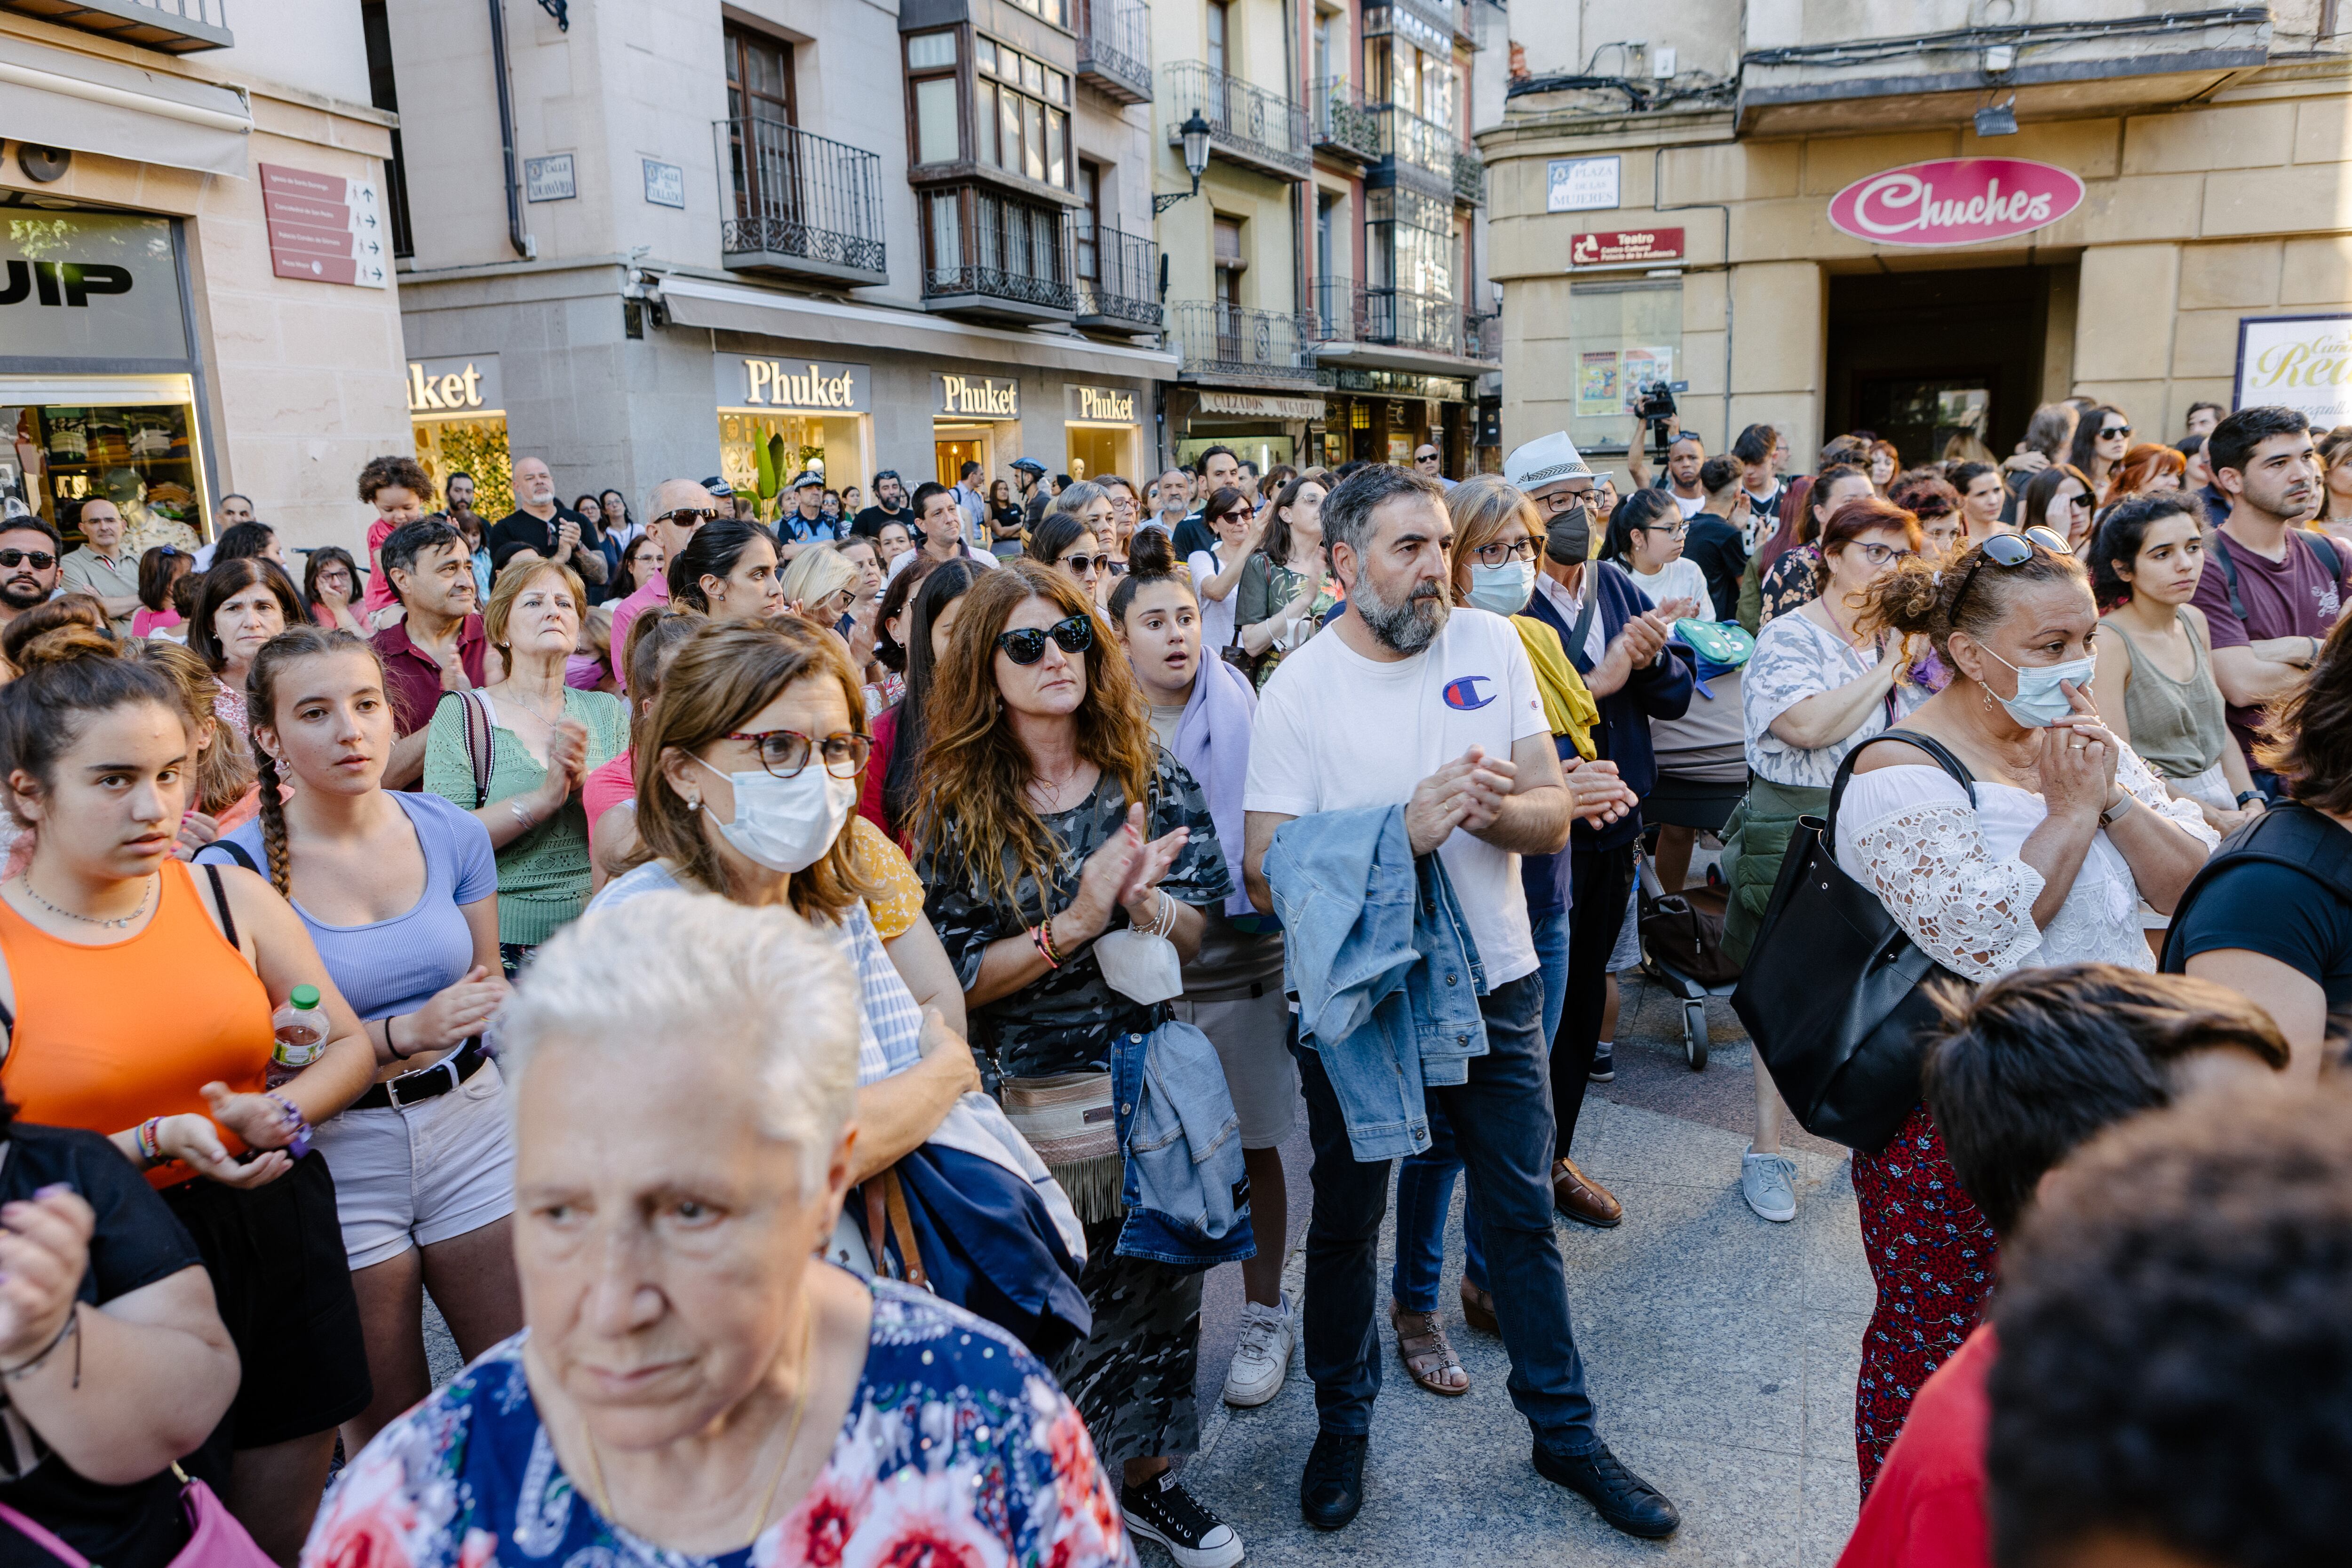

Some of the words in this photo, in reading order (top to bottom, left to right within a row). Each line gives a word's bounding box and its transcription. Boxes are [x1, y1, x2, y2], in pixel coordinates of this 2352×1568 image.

[1576, 166, 1613, 178] PLAZA
[1554, 191, 1613, 205] MUJERES
[1854, 173, 2052, 234] Chuches
[1618, 233, 1655, 245] Teatro
[745, 359, 854, 407] Phuket
[2250, 341, 2352, 389] Rea
[406, 363, 483, 410] ket
[943, 375, 1017, 415] Phuket
[1080, 388, 1134, 421] Phuket
[1214, 394, 1264, 410] CALZADOS
